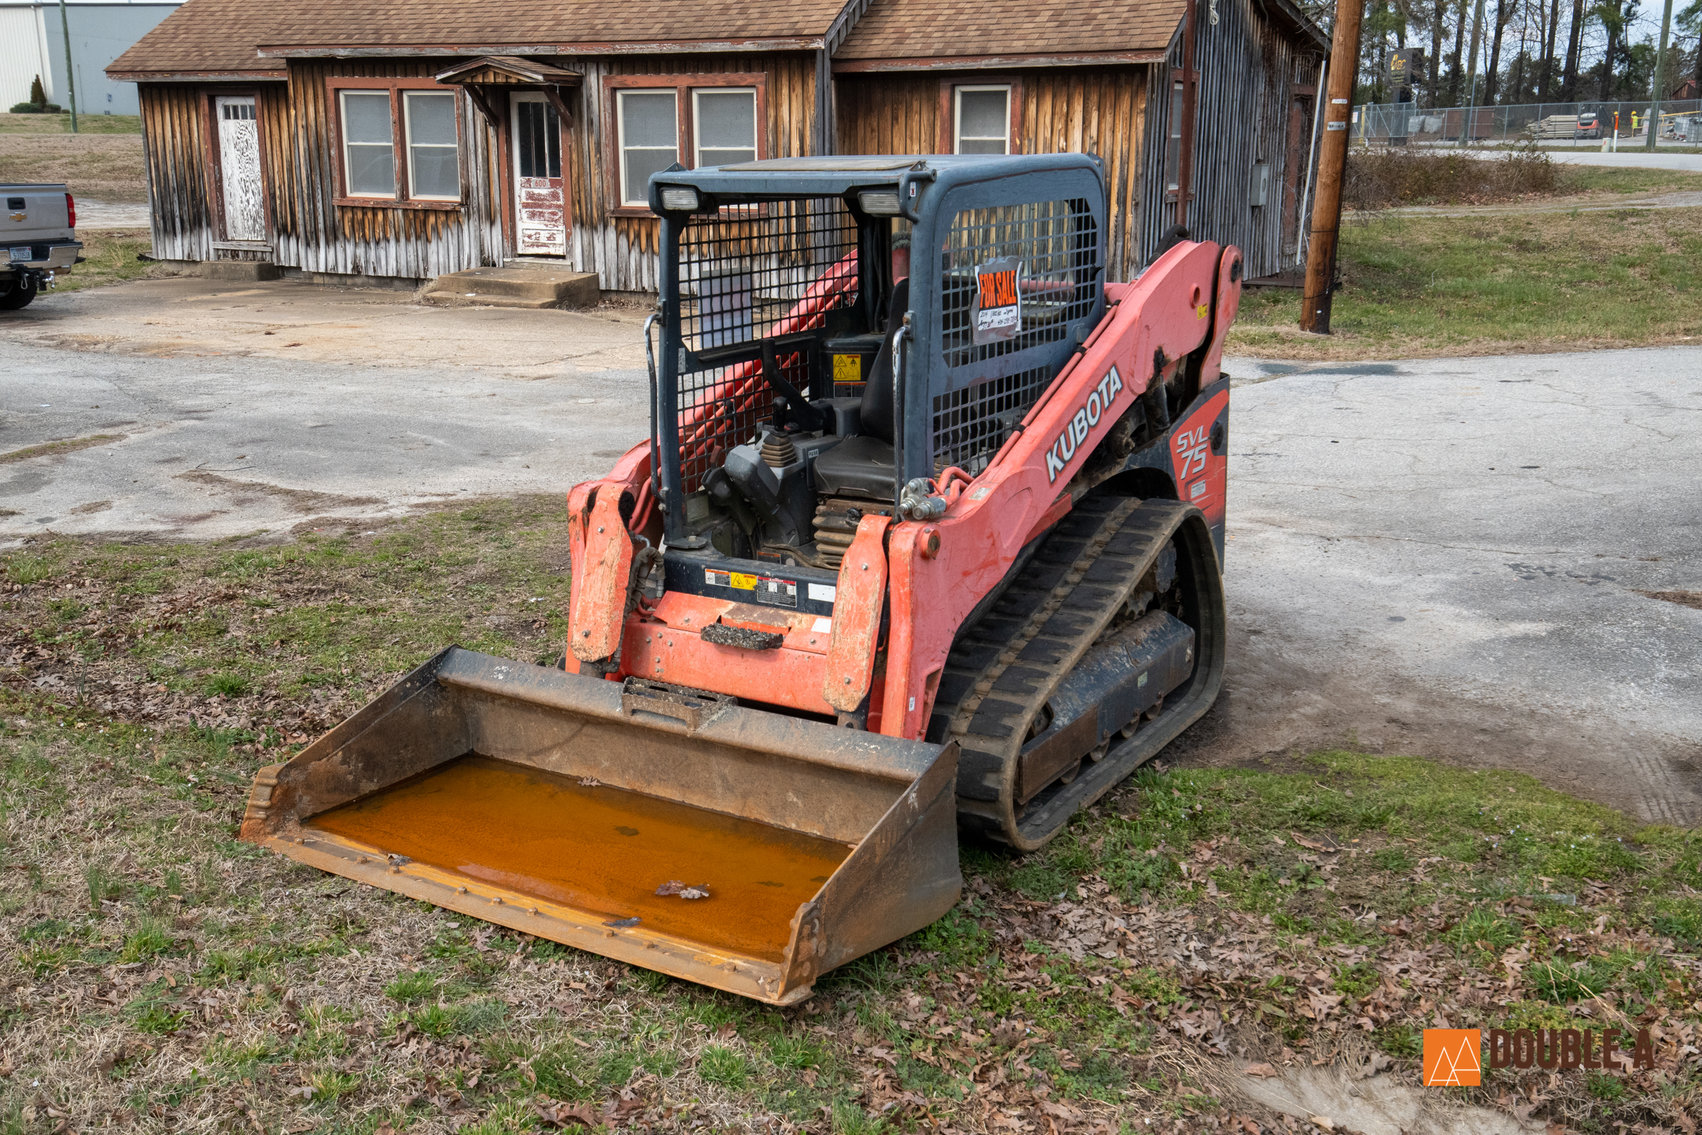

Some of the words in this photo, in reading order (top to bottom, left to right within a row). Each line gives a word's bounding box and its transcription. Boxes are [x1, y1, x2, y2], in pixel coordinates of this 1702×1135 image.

[534, 180, 547, 188] 600
[979, 272, 996, 308] FOR
[995, 270, 1017, 306] SALE
[1045, 365, 1123, 483] KUBOTA
[1176, 425, 1209, 453] SVL
[1180, 443, 1208, 480] 75
